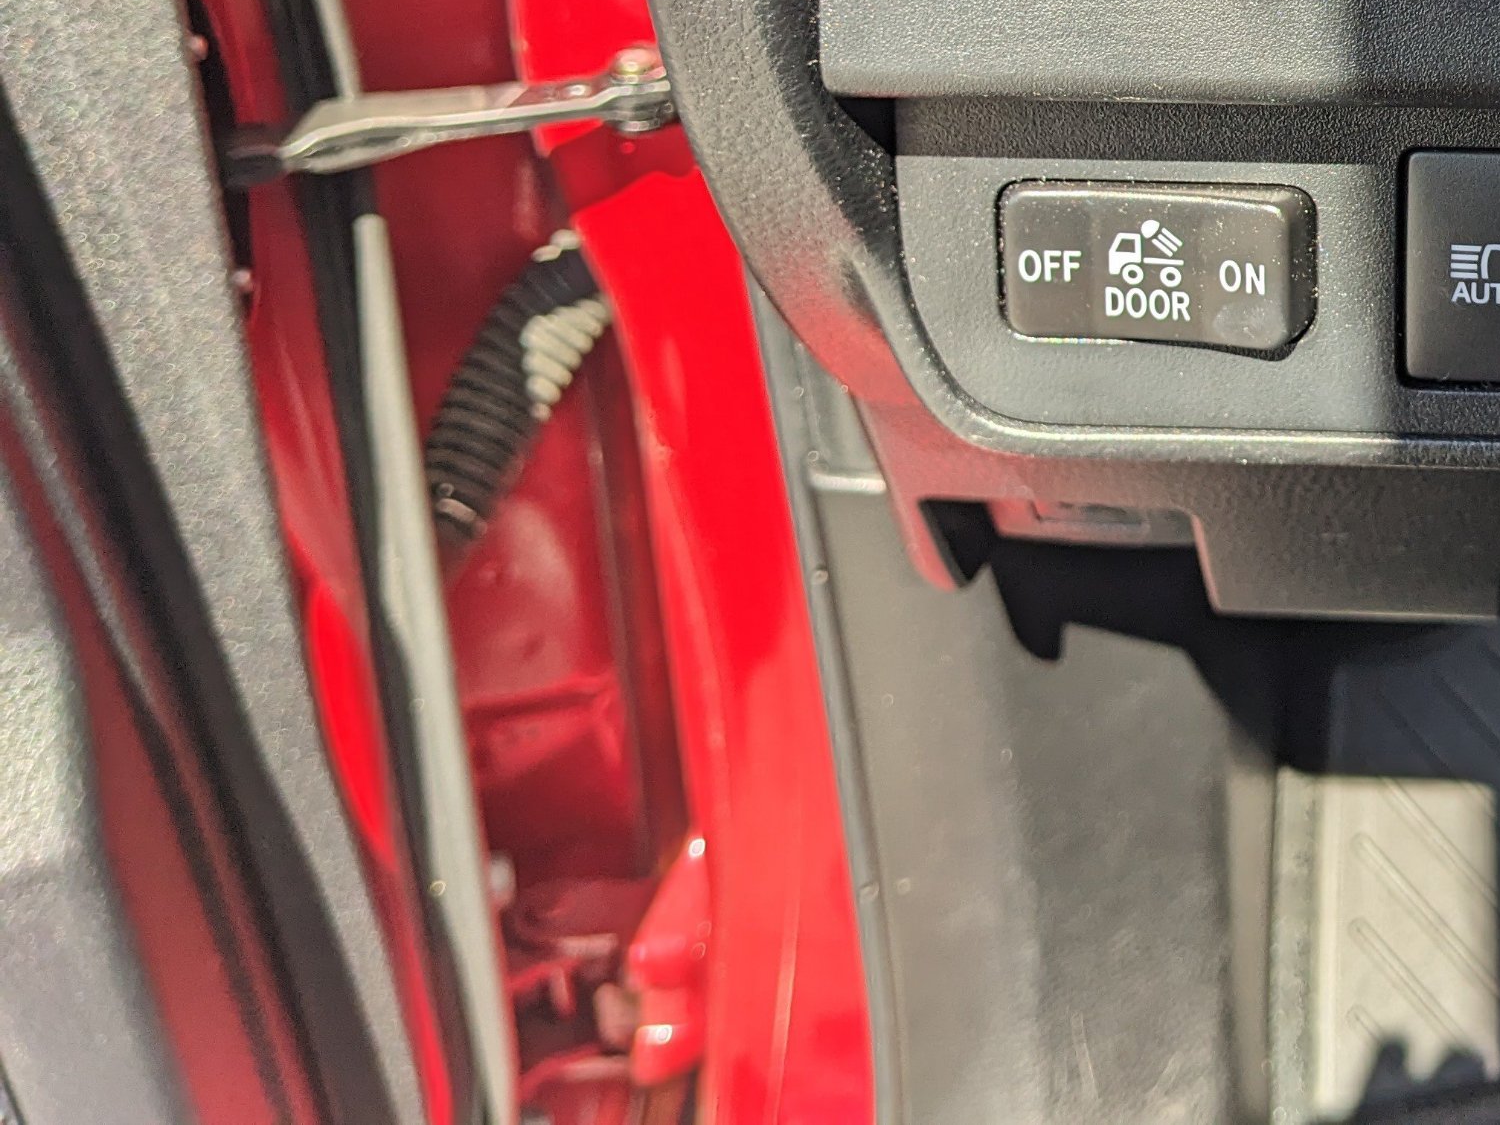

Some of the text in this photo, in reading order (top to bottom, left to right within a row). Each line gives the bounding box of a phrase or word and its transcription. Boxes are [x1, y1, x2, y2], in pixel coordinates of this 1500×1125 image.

[1017, 249, 1082, 283] OFF
[1218, 259, 1266, 296] ON
[1104, 286, 1192, 322] DOOR
